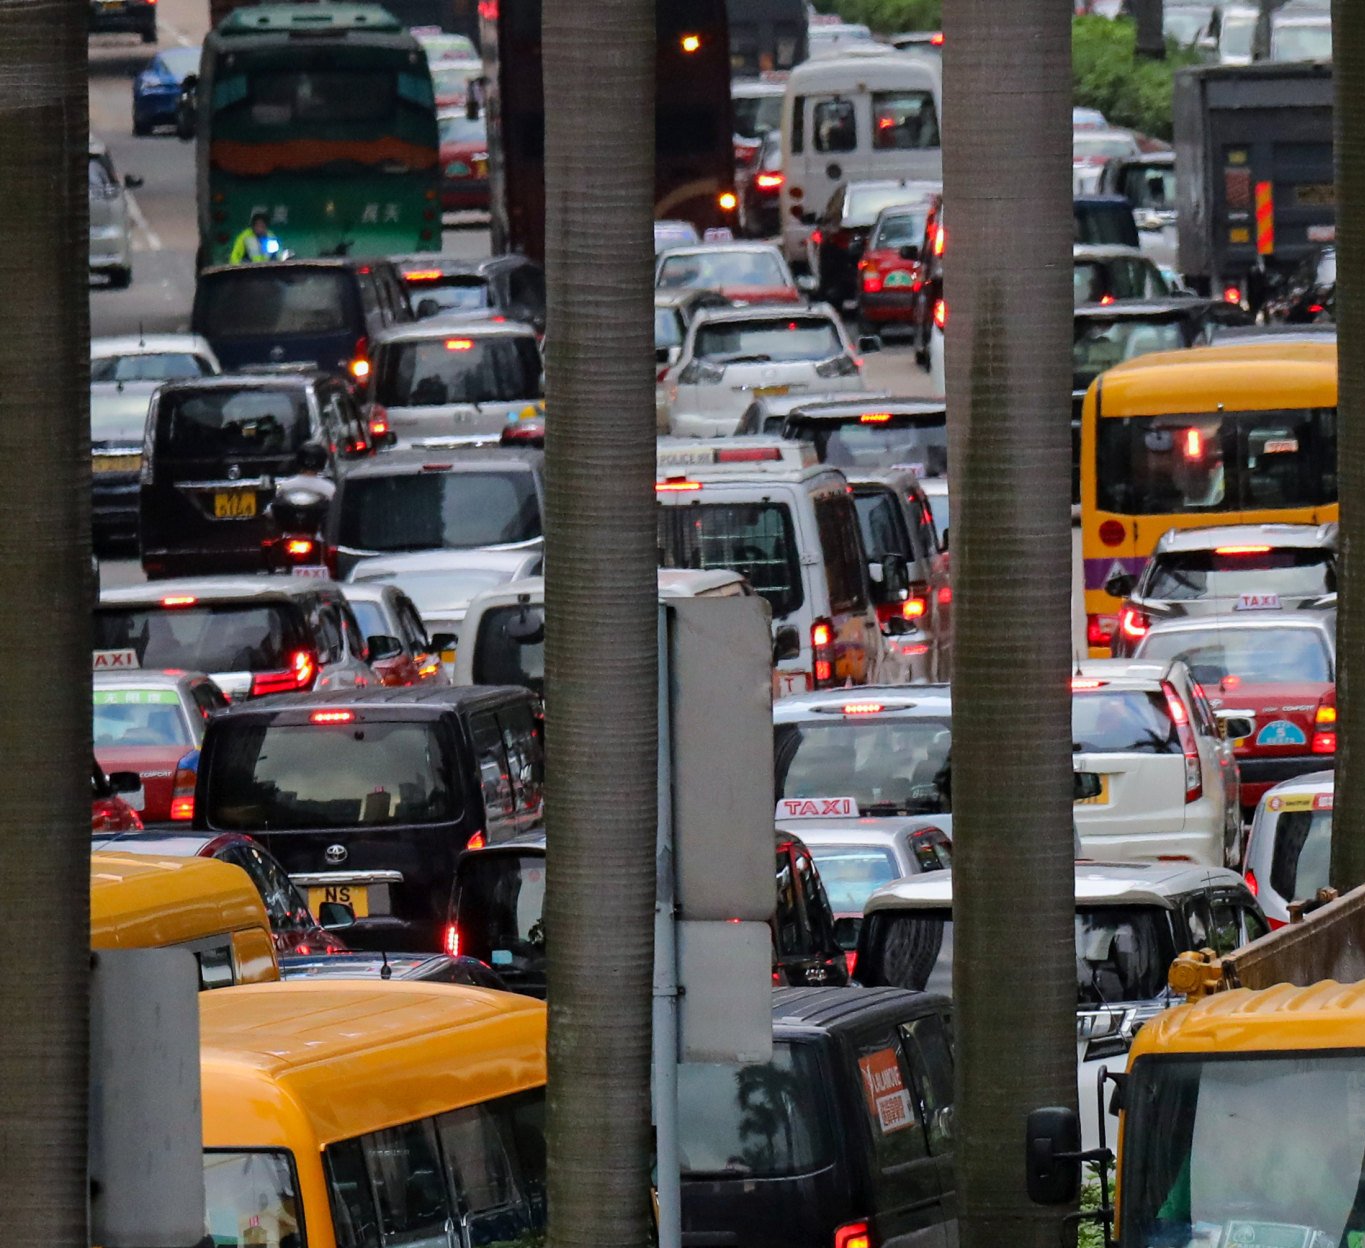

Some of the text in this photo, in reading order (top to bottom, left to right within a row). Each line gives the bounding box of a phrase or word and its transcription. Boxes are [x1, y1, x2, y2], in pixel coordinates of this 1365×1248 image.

[1242, 596, 1277, 606] TAXI
[785, 799, 851, 815] TAXI
[326, 887, 350, 903] NS
